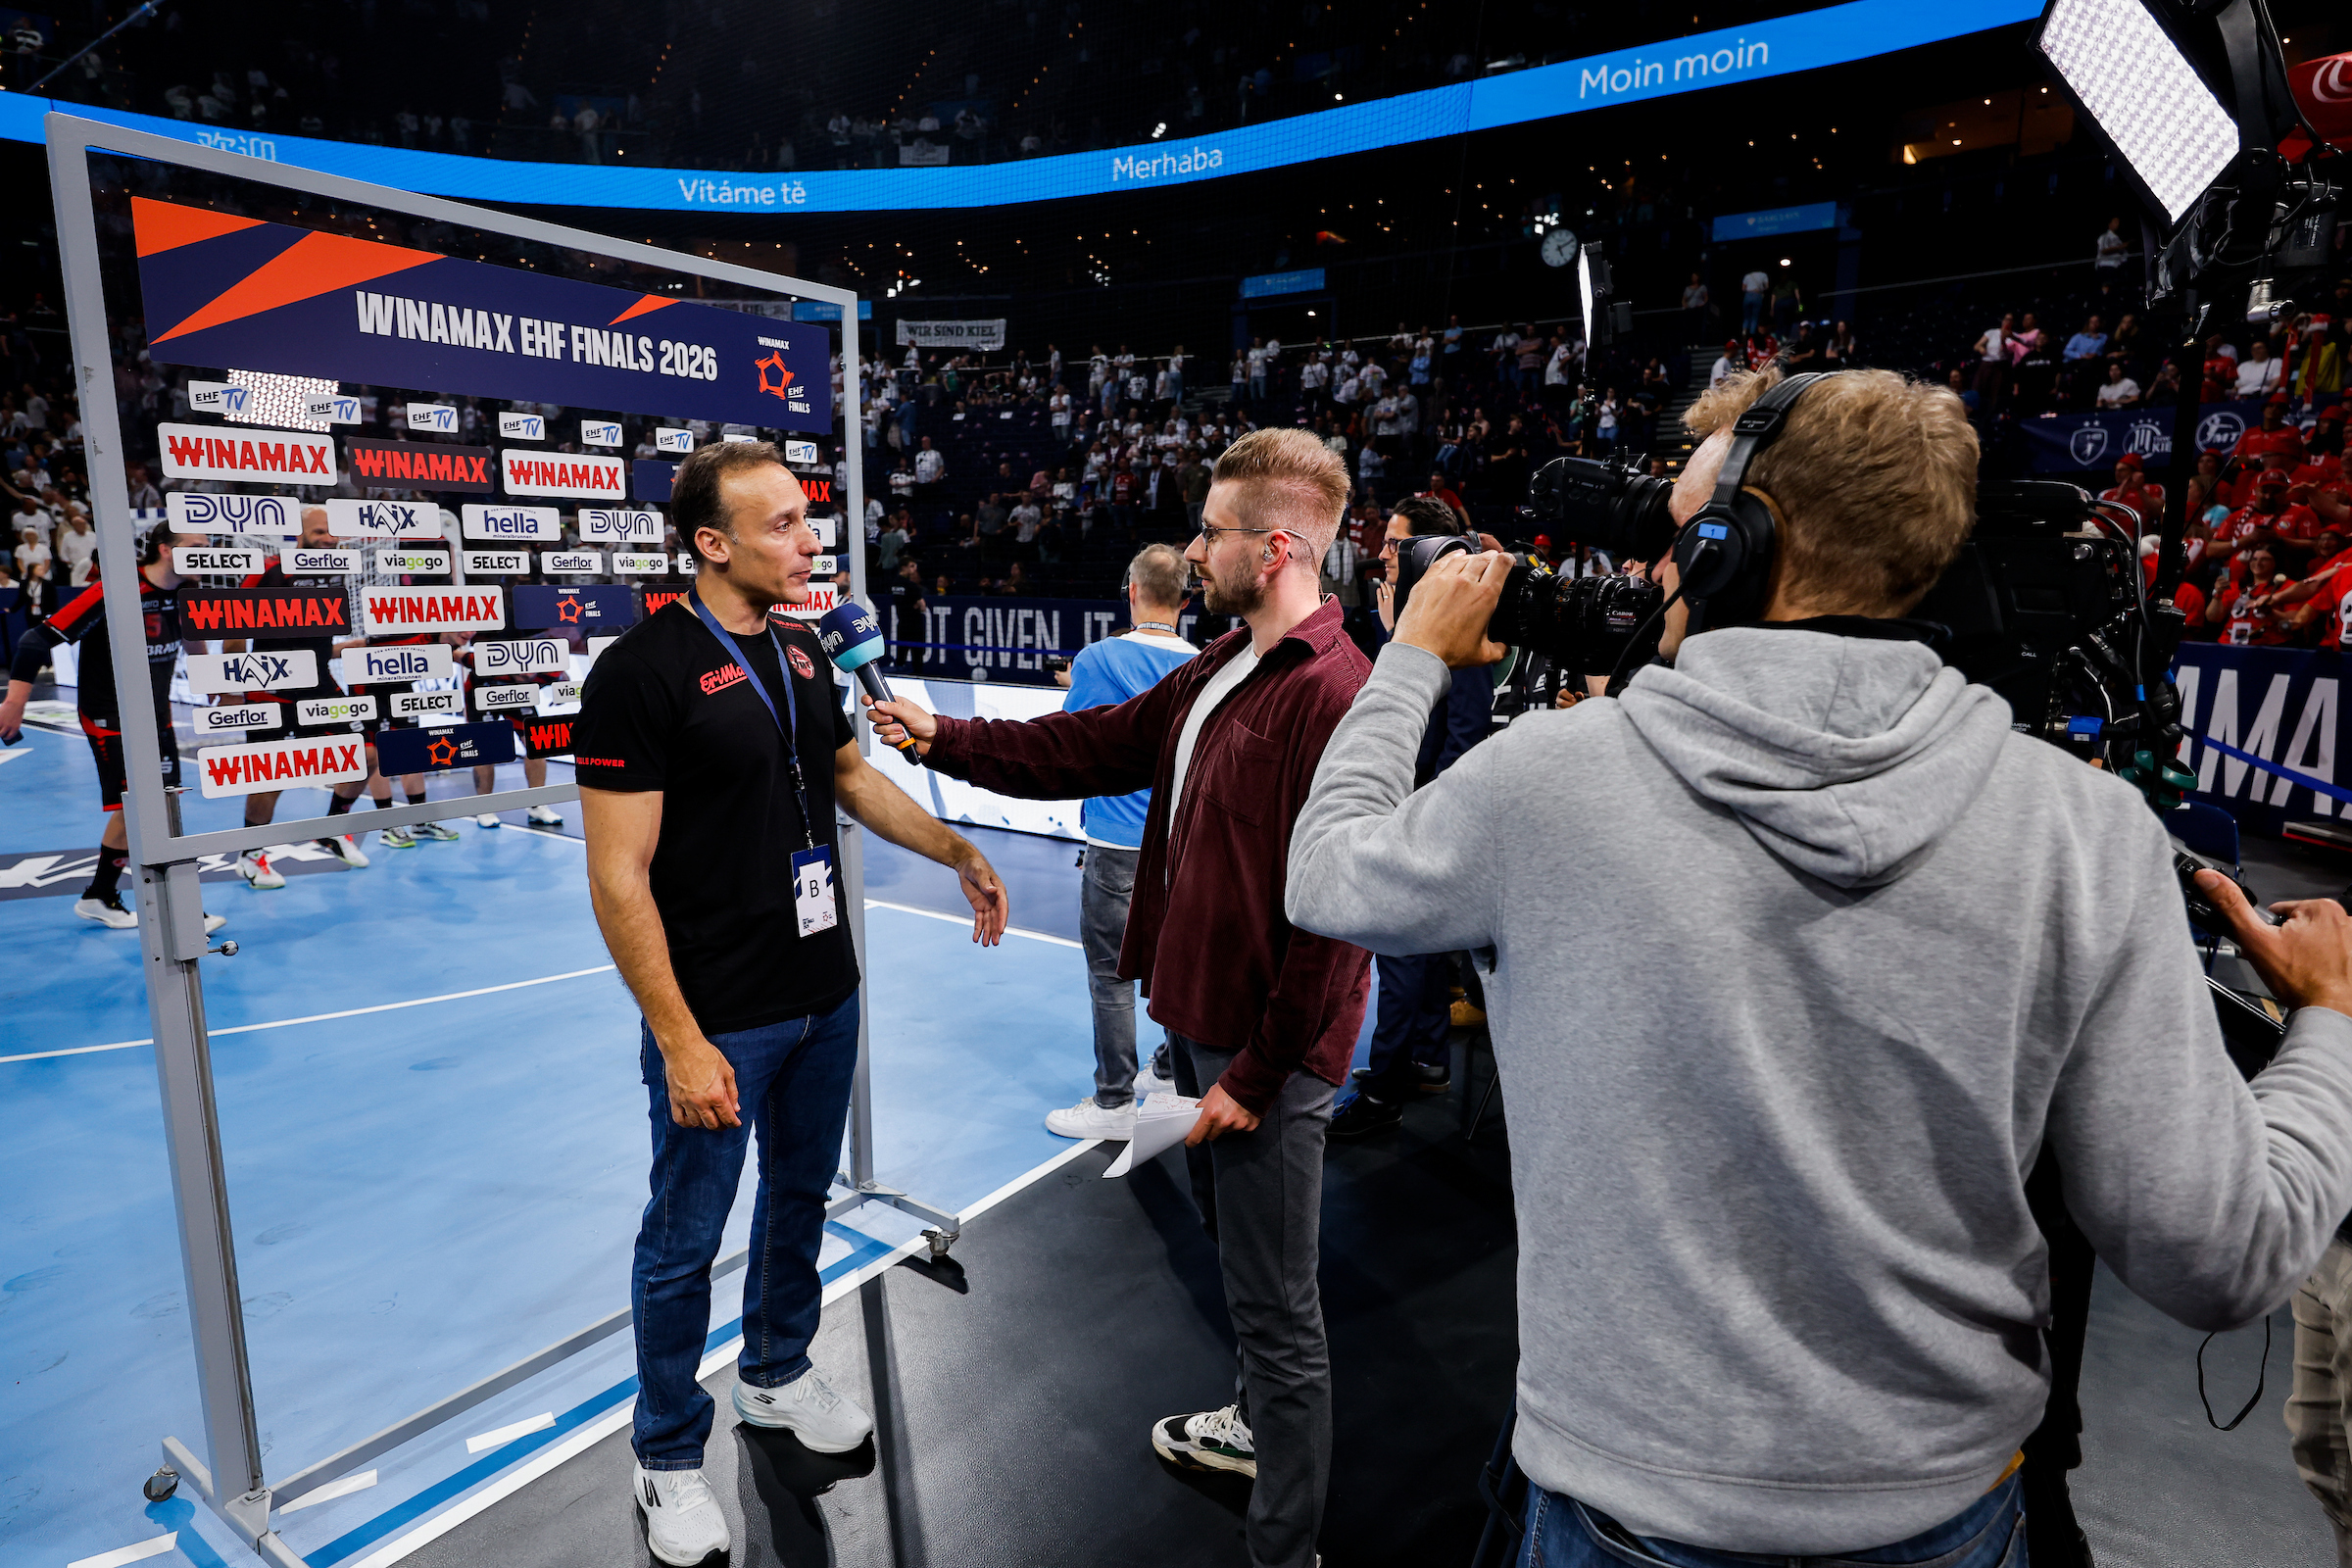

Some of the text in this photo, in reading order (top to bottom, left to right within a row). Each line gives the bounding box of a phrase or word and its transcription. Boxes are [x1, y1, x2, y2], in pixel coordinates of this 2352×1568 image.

[1580, 37, 1769, 99] Moin moin
[1112, 146, 1223, 182] Merhaba
[678, 178, 807, 206] Vítáme tě
[356, 290, 718, 382] WINAMAX EHF FINALS 2026
[906, 325, 996, 337] WIR SIND KIEL
[758, 335, 790, 351] WINAMAX
[195, 388, 248, 411] EHF TV
[788, 386, 805, 397] EHF
[310, 400, 358, 420] EHF TV
[788, 401, 811, 415] FINALS
[413, 409, 455, 429] EHF TV
[504, 417, 541, 437] EHF TV
[585, 425, 620, 445] EHF TV
[660, 432, 691, 450] EHF TV
[168, 435, 329, 474] WINAMAX
[788, 445, 815, 461] EHF TV
[354, 448, 488, 484] WINAMAX
[509, 459, 620, 490] WINAMAX
[483, 510, 539, 533] hella
[1709, 527, 1716, 537] 1
[186, 554, 252, 569] SELECT
[384, 554, 443, 570] viagogo
[472, 556, 520, 569] SELECT
[619, 557, 663, 570] viagogo
[186, 597, 345, 630] WINAMAX
[368, 595, 499, 624] WINAMAX
[367, 653, 428, 676] hella
[306, 703, 368, 719] viagogo
[401, 695, 453, 711] SELECT
[427, 727, 454, 736] WINAMAX
[461, 749, 479, 759] FINALS
[590, 758, 625, 767] POWER
[207, 744, 360, 786] WINAMAX
[809, 879, 819, 898] B
